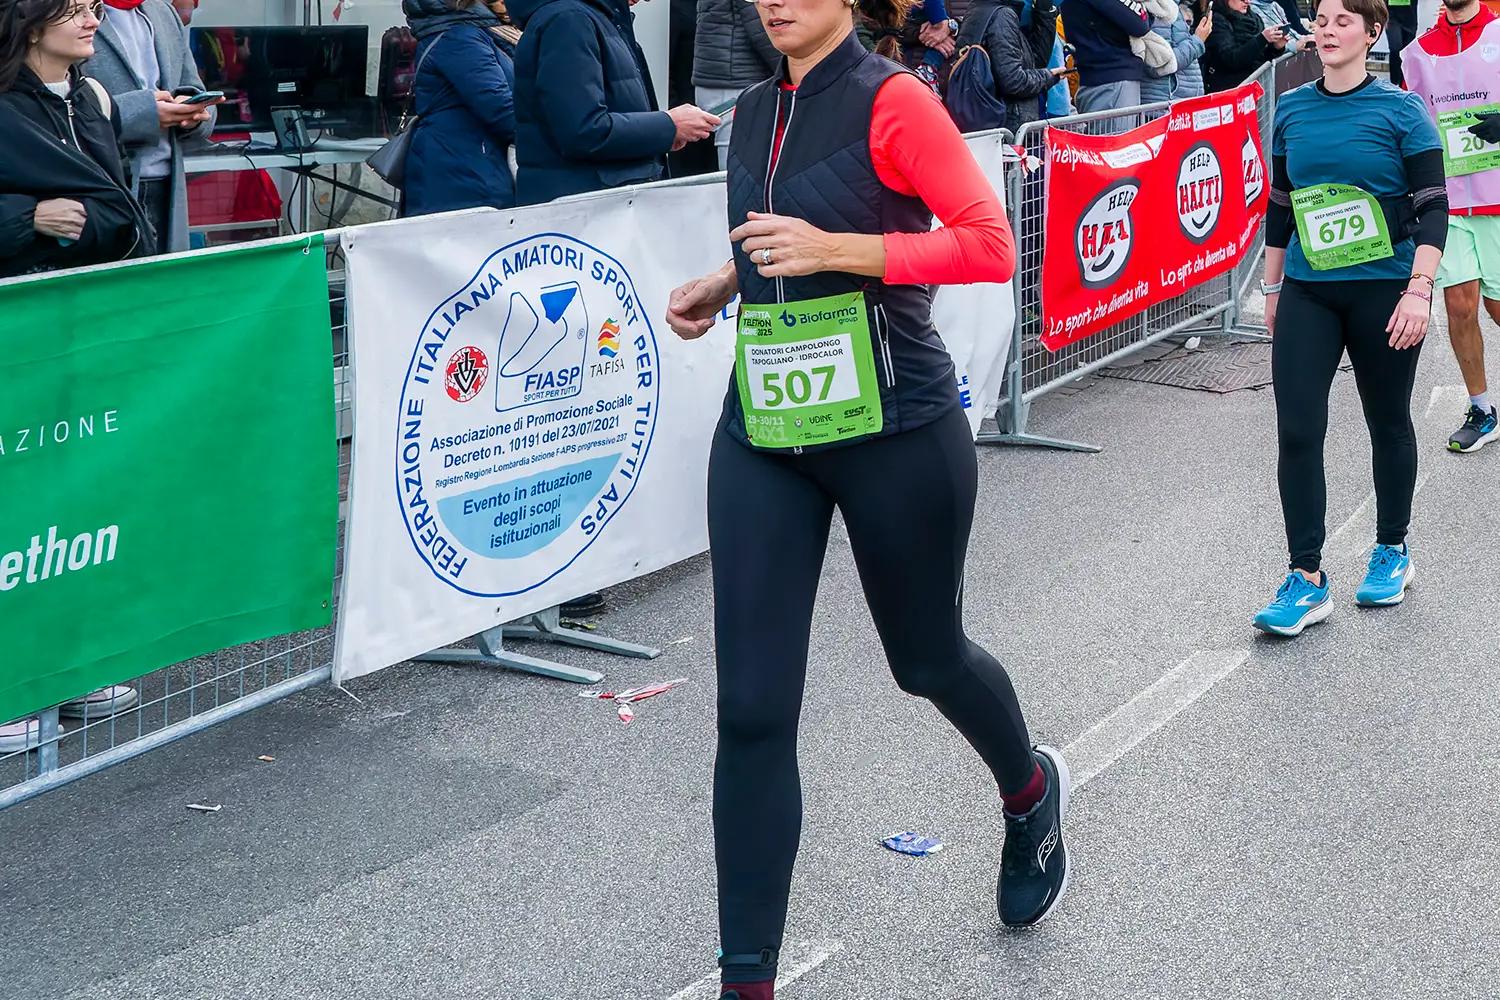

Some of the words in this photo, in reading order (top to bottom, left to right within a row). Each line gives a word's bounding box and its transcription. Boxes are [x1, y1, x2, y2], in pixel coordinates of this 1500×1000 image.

[1435, 90, 1489, 104] webindustry
[1190, 152, 1210, 172] HELP
[1179, 175, 1220, 215] HAITI
[1295, 193, 1323, 205] TELETHON
[1319, 214, 1365, 244] 679
[1325, 208, 1344, 218] MOVING
[502, 244, 584, 280] AMATORI
[1160, 268, 1176, 287] Lo
[591, 260, 639, 327] SPORT
[1049, 316, 1063, 337] Lo
[1065, 307, 1092, 339] sport
[1093, 299, 1108, 322] che
[1108, 288, 1133, 314] diventa
[1134, 280, 1149, 301] vita
[414, 273, 503, 384] ITALIANA
[799, 306, 857, 325] Biofarma
[838, 316, 858, 325] group
[634, 334, 652, 389] PER
[751, 355, 794, 365] TAPOGLIANO
[799, 348, 844, 361] IDROCALOR
[752, 347, 784, 356] DONATORI
[785, 338, 841, 354] CAMPOLONGO
[523, 366, 580, 393] FIASP
[590, 358, 625, 378] TAFISA
[560, 386, 576, 396] TUTTI
[763, 365, 836, 408] 507
[429, 422, 511, 452] Associazione
[513, 416, 523, 430] di
[527, 404, 594, 428] Promozione
[596, 393, 633, 413] Sociale
[747, 415, 785, 426] 29-30/11
[808, 413, 834, 425] UDINE
[444, 448, 491, 468] Decreto
[494, 442, 505, 456] n.
[509, 431, 540, 452] 10191
[542, 427, 560, 445] del
[562, 415, 619, 440] 23/07/2021
[619, 401, 651, 480] TUTTI
[435, 474, 463, 489] Registro
[464, 467, 492, 480] Regione
[493, 456, 530, 473] Lombardia
[577, 437, 615, 453] progressivo
[616, 433, 628, 443] 237
[403, 399, 468, 578] FEDERAZIONE
[463, 492, 510, 515] Evento
[514, 486, 527, 501] in
[530, 468, 593, 497] attuazione
[493, 509, 527, 528] degli
[529, 494, 561, 517] scopi
[581, 482, 619, 536] APS
[490, 514, 561, 549] istituzionali
